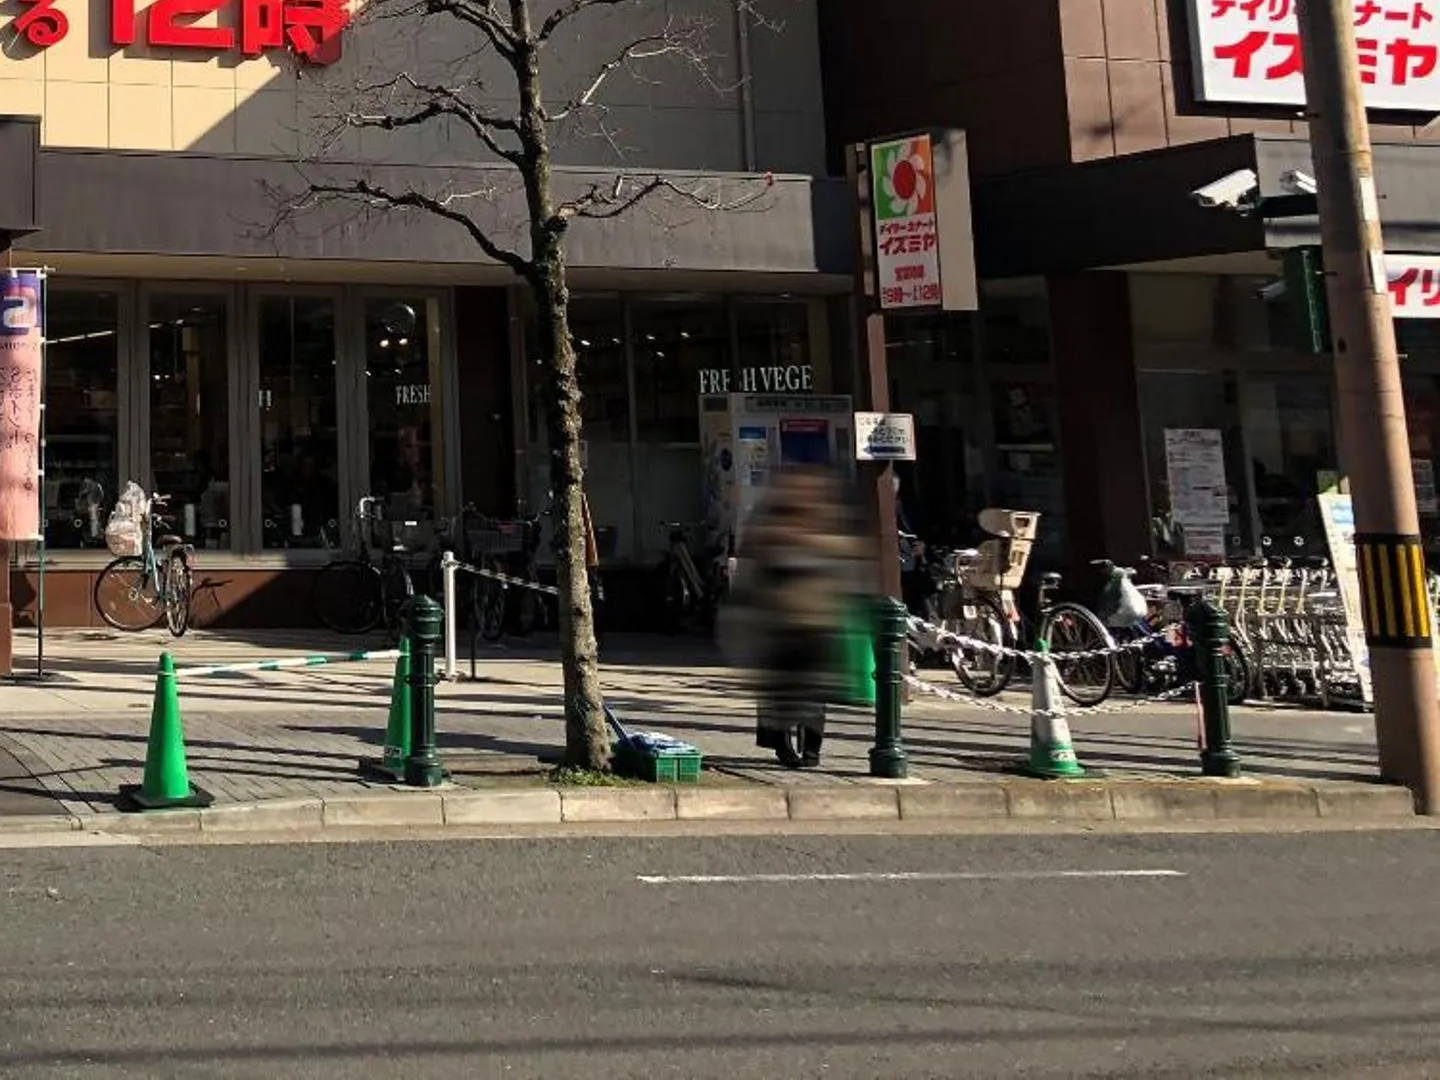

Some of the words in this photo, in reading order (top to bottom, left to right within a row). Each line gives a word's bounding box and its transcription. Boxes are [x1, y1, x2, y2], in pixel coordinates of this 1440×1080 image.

[698, 367, 758, 394] FREH
[759, 364, 812, 392] VEGE
[395, 383, 433, 406] FRESH
